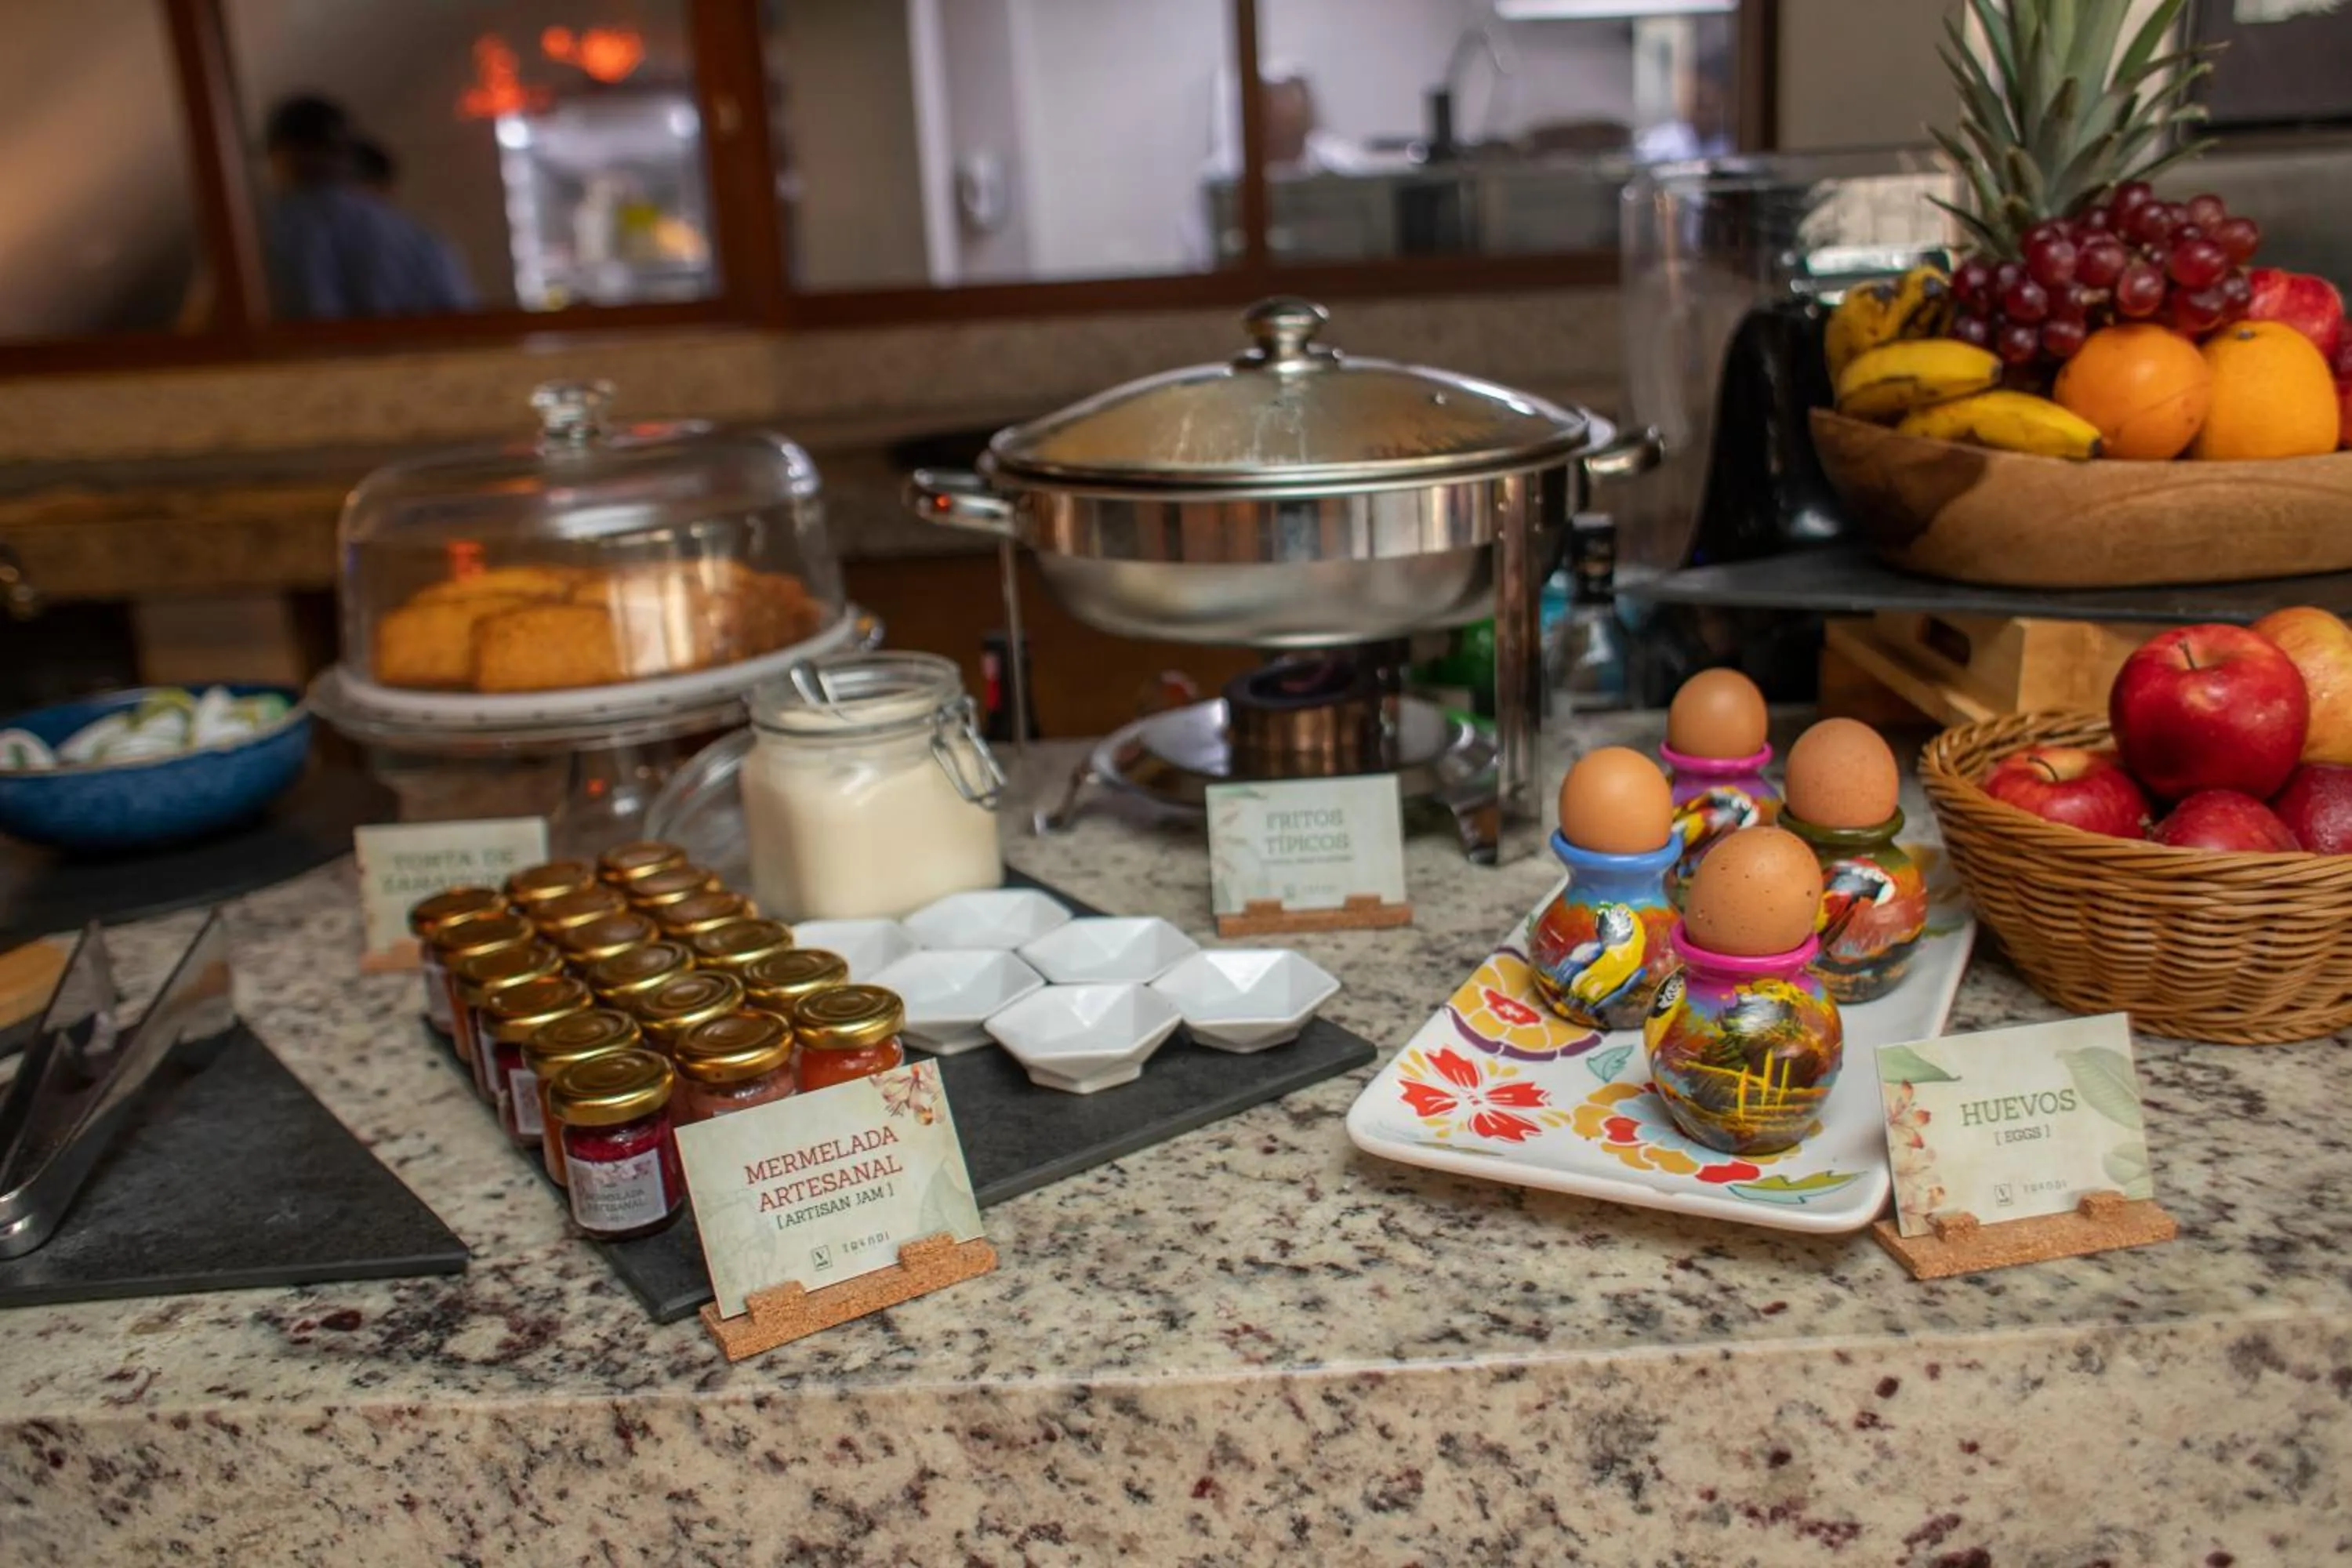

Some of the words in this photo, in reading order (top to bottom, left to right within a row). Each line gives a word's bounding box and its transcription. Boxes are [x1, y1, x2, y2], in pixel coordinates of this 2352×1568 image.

[1265, 808, 1344, 829] FRITOS
[1961, 1088, 2077, 1127] HUEVOS
[744, 1126, 899, 1185] MERMELADA
[760, 1155, 903, 1212] ARTESANAL
